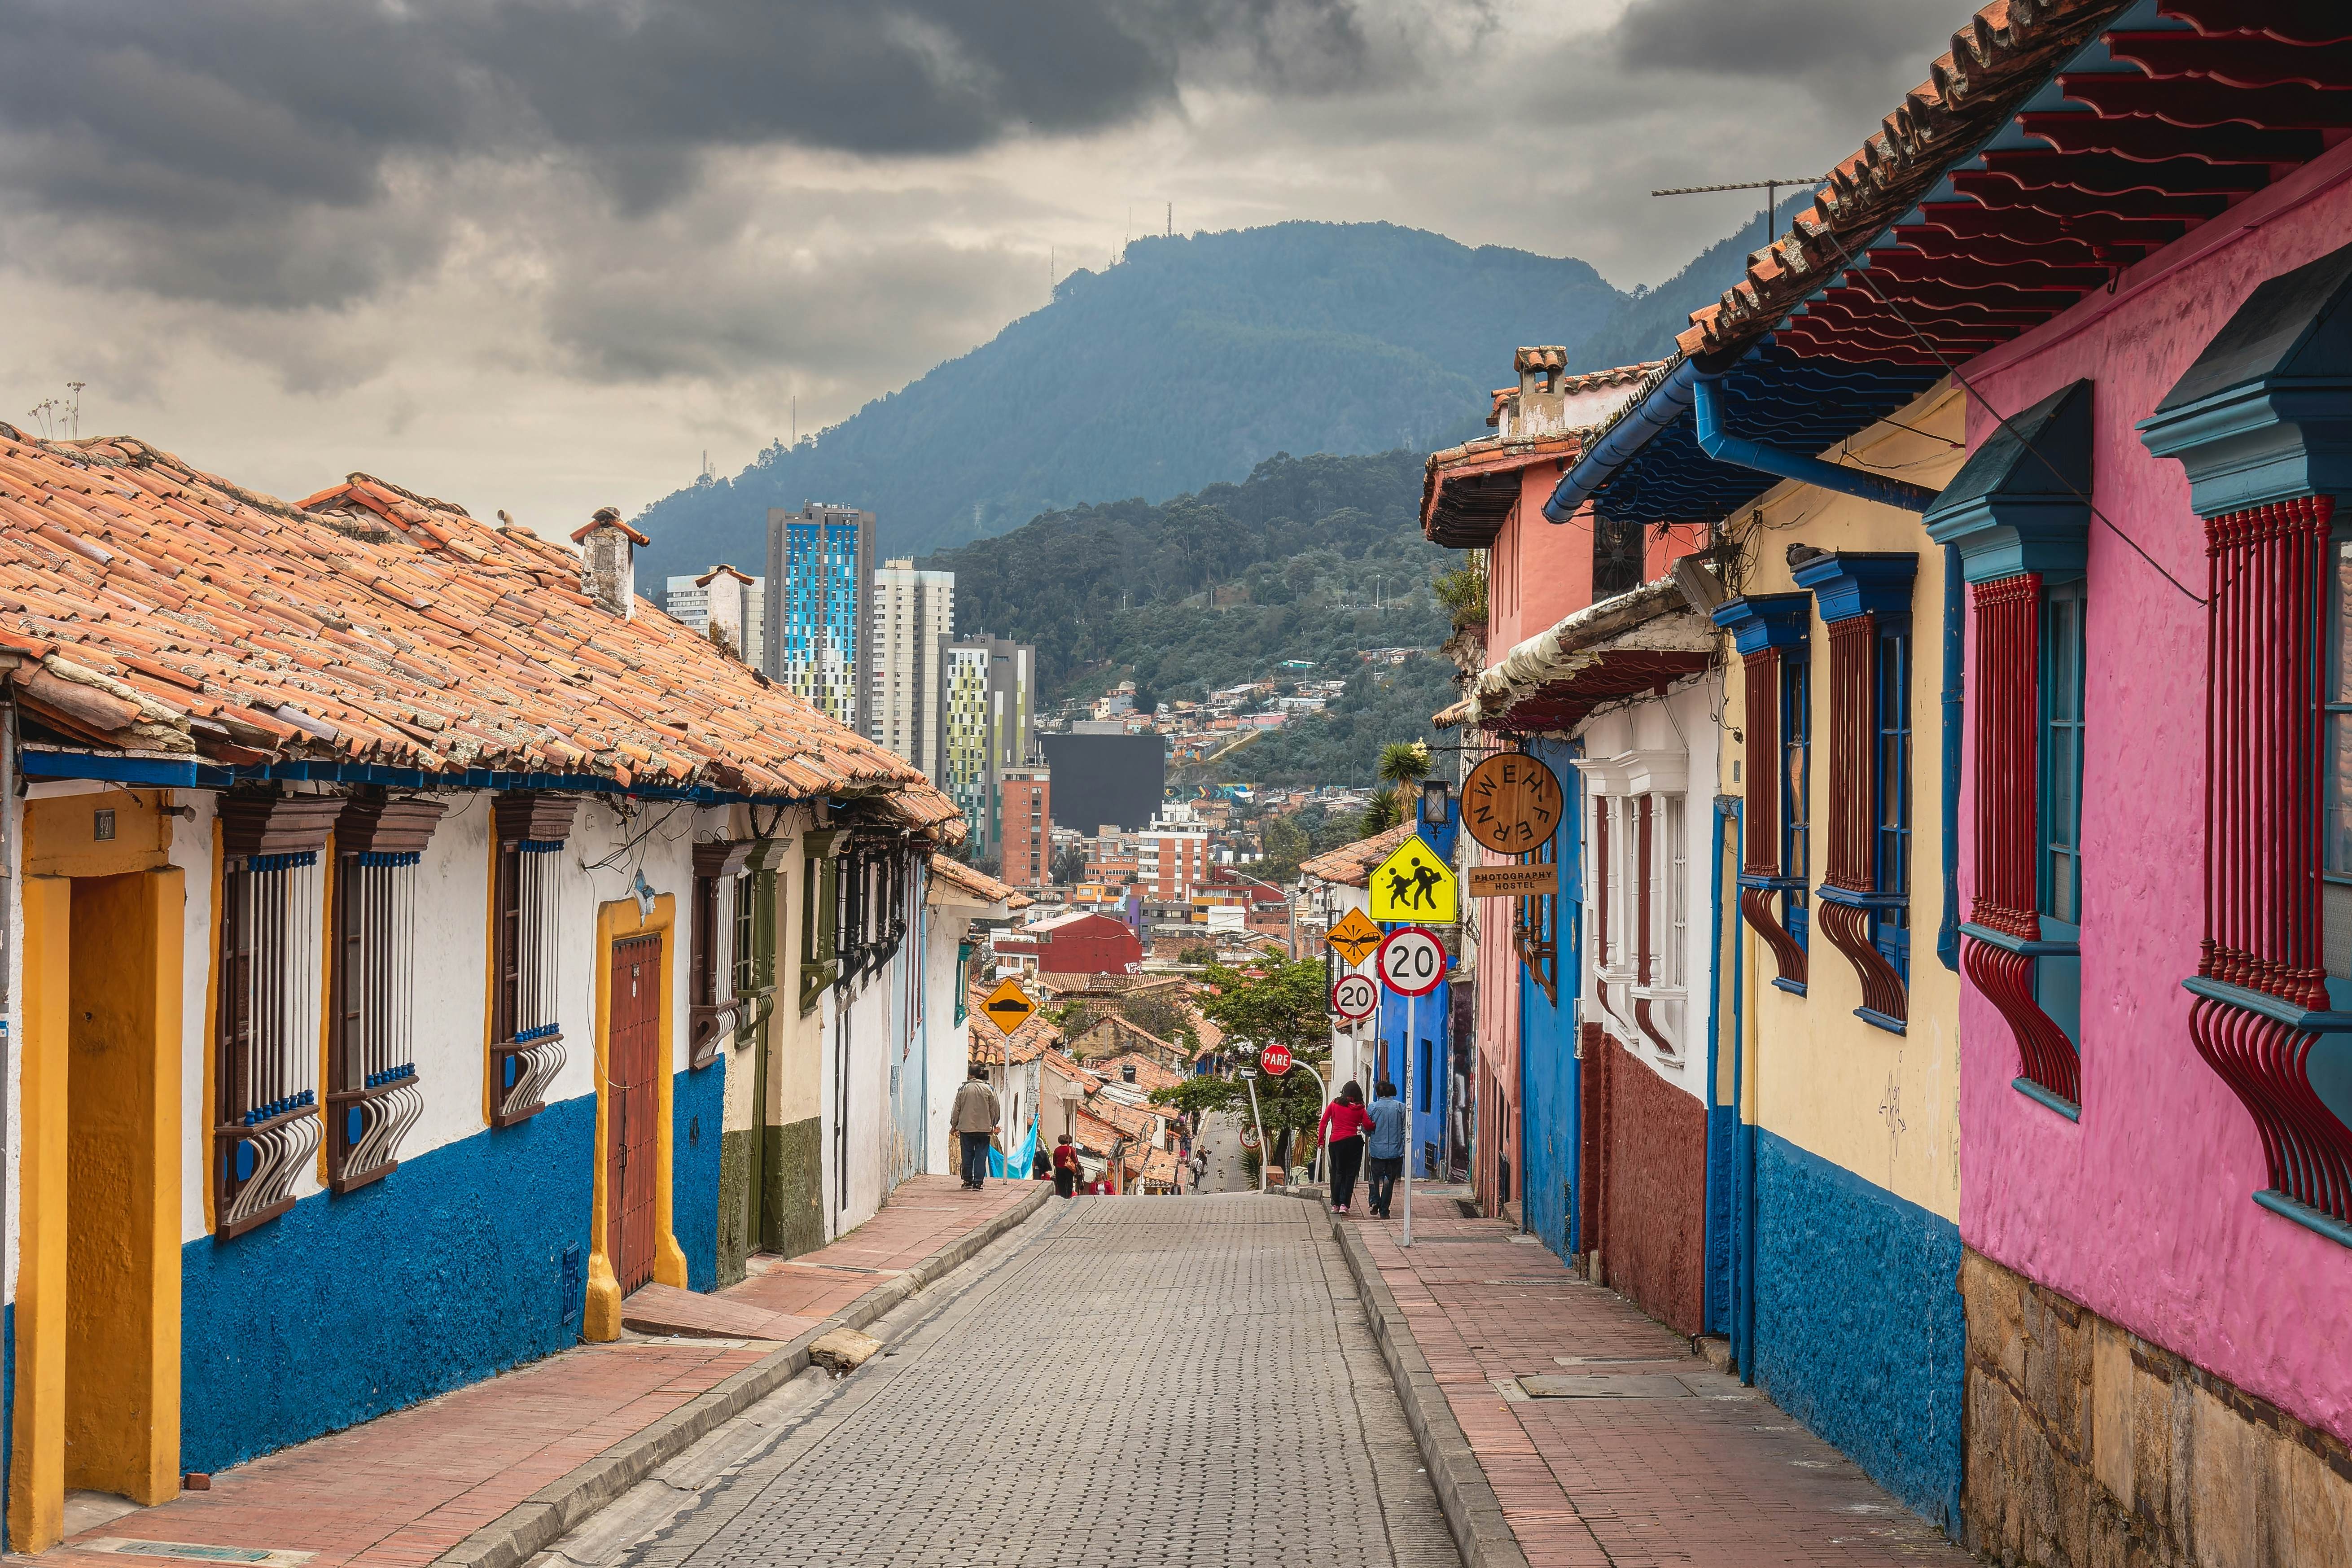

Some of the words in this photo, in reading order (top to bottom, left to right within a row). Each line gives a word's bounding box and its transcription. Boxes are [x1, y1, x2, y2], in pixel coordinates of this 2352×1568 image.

[1475, 872, 1552, 882] PHOTOGRAPHY
[1495, 881, 1535, 890] HOSTEL
[1391, 945, 1434, 977] 20
[1340, 986, 1369, 1007] 20
[1264, 1052, 1289, 1066] PARE
